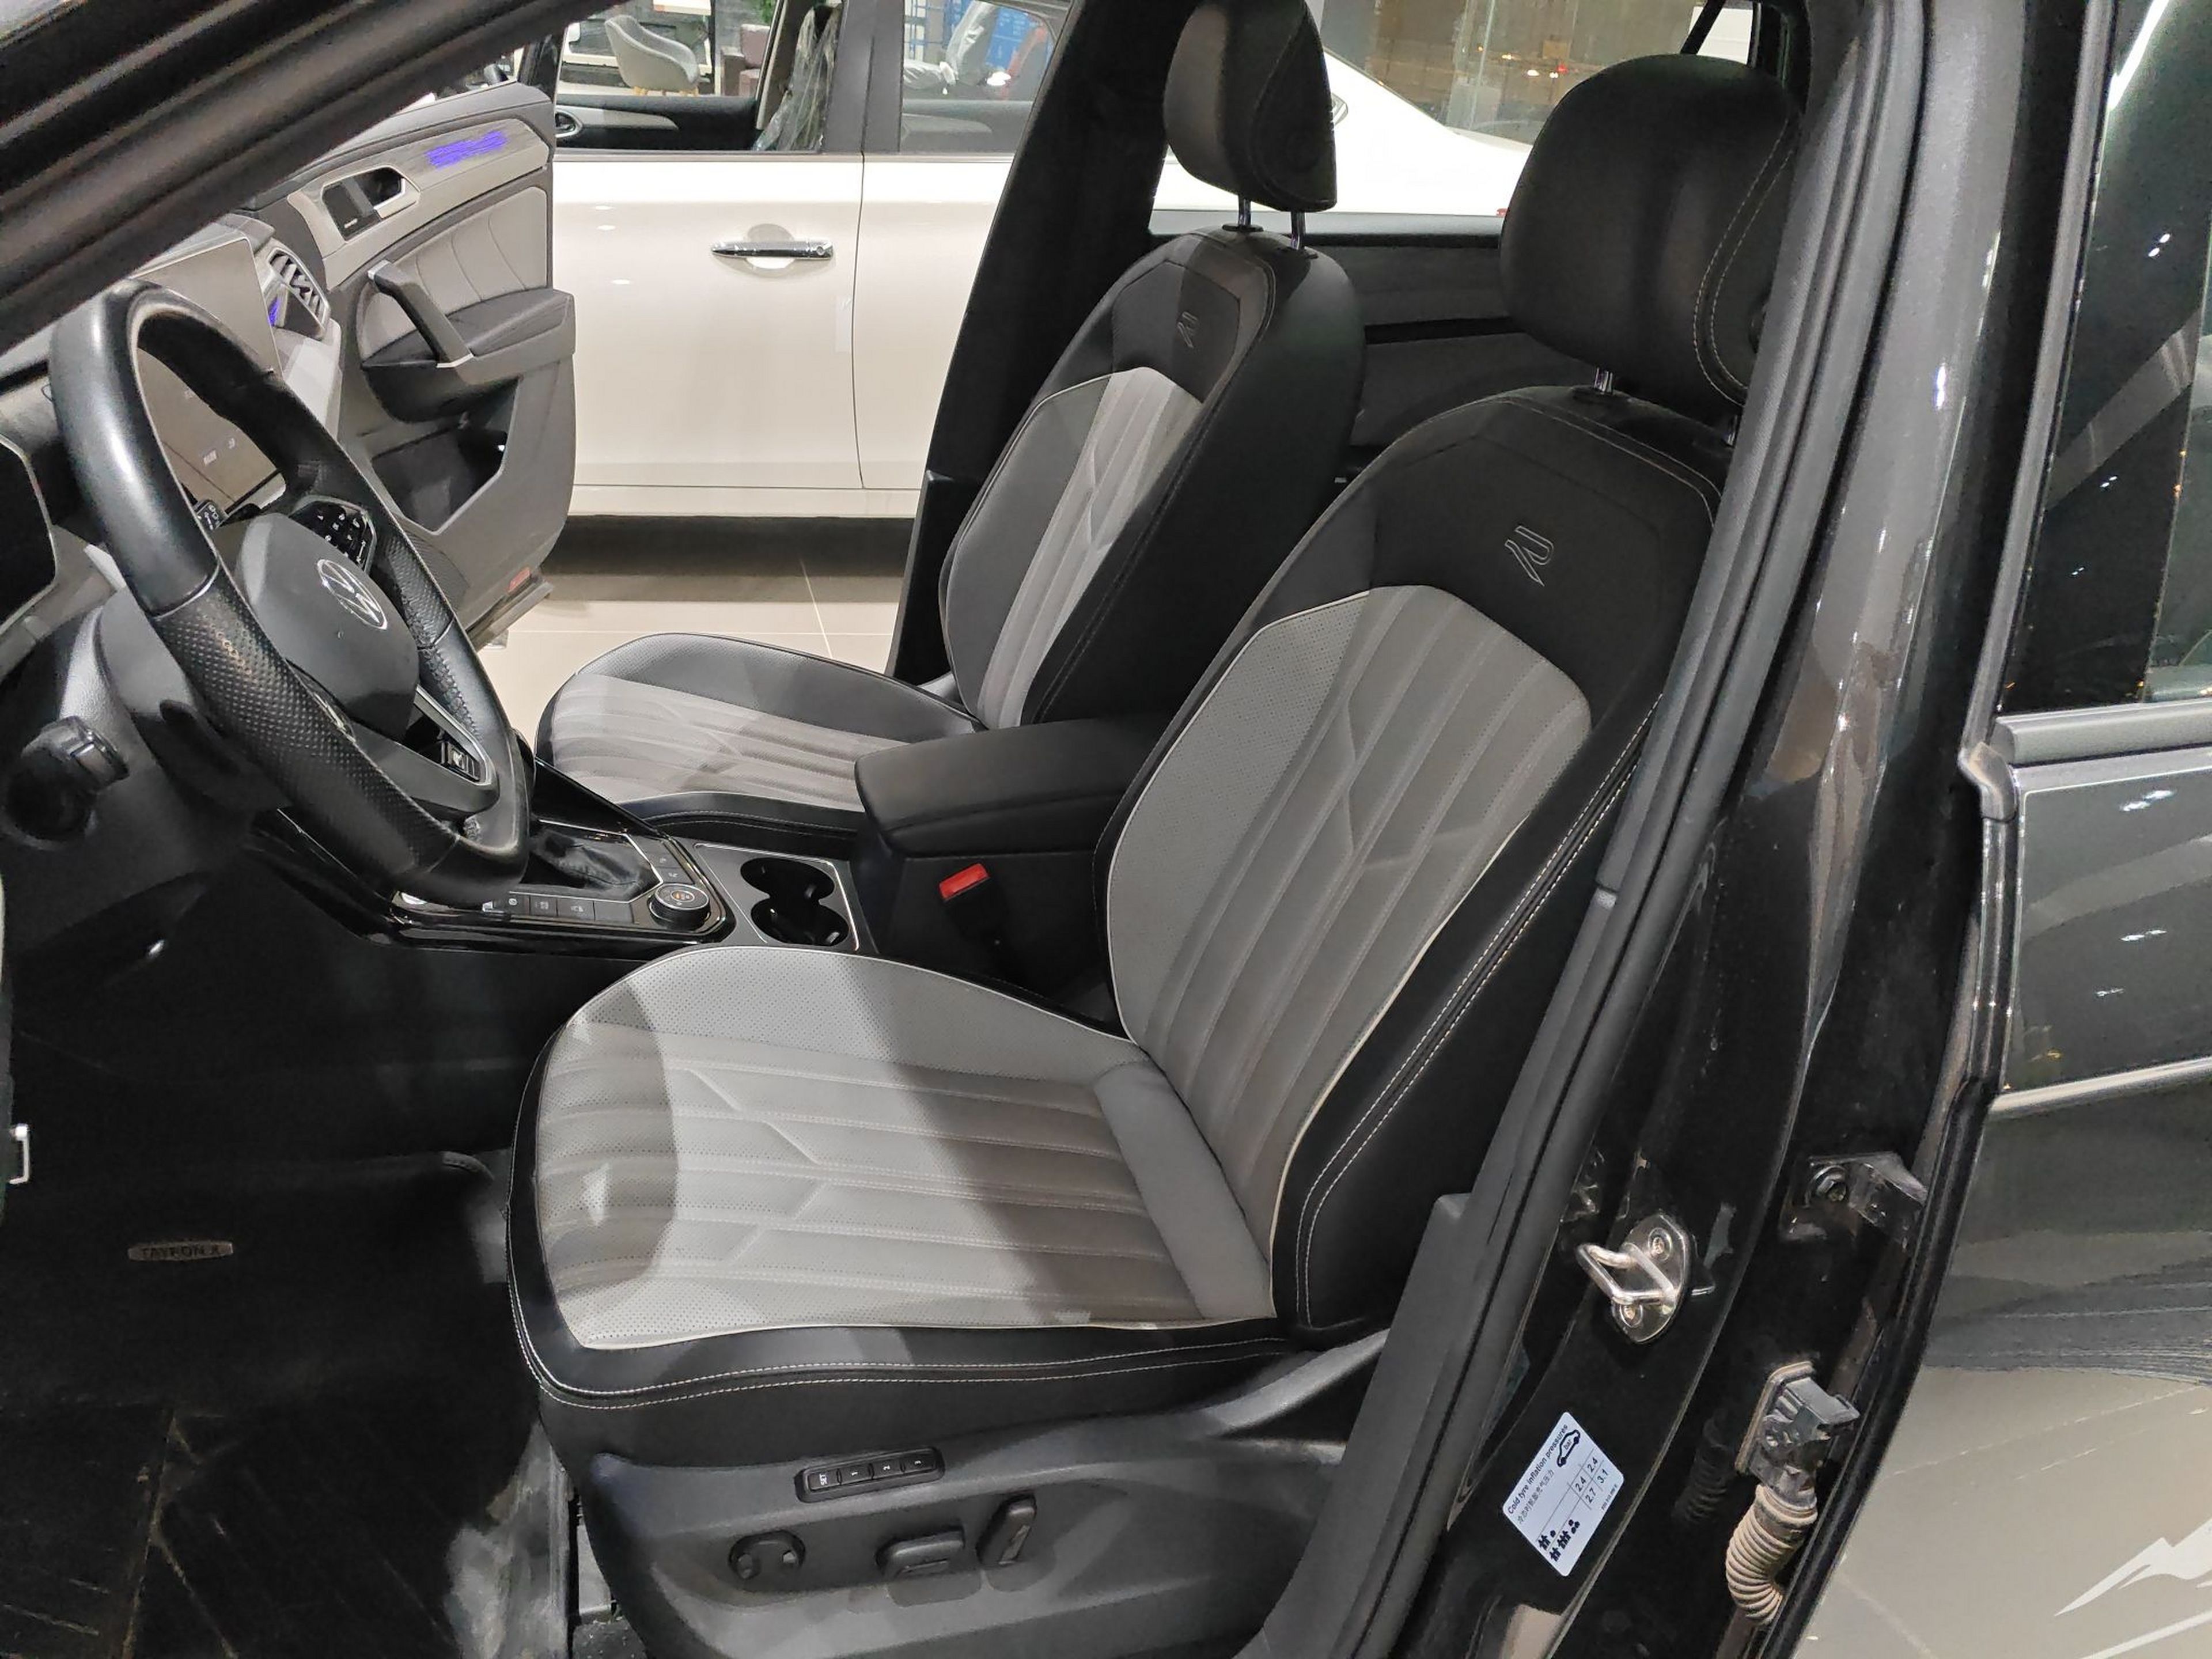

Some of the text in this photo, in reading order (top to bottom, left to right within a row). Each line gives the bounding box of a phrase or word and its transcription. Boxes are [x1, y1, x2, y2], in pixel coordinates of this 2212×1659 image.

[1504, 525, 1554, 587] R
[1564, 1440, 1573, 1449] bar
[1508, 1425, 1569, 1514] Cold tyre inflation pressures
[1575, 1457, 1598, 1492] 2.4 2.4
[1586, 1469, 1608, 1503] 2.7 3.1
